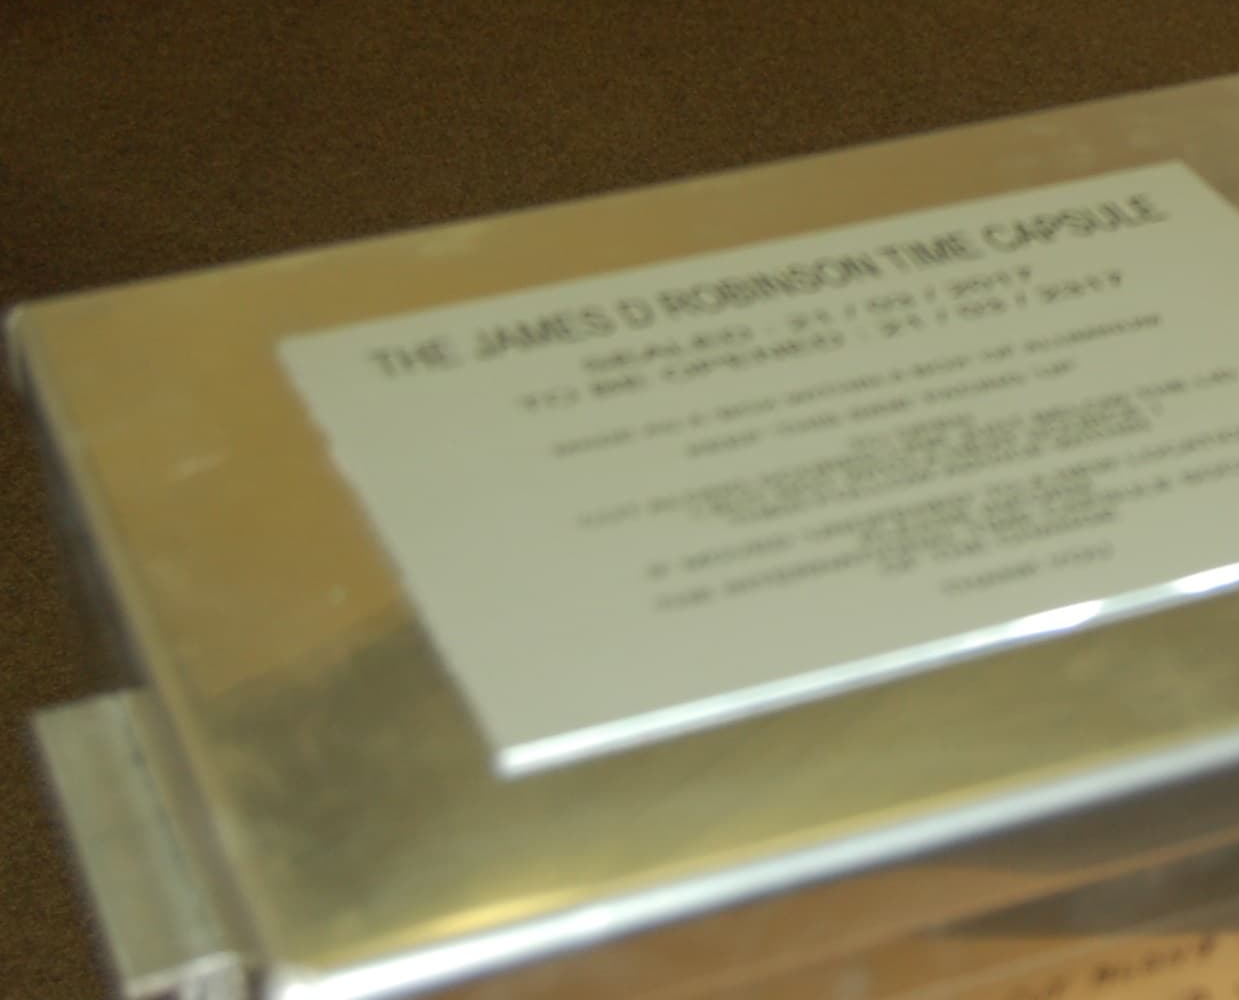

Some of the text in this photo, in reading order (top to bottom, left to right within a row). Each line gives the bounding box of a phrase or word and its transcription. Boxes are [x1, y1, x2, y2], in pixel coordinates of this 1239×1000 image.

[370, 197, 1166, 377] THE JAMES D ROBINSON TIME CAPSULE
